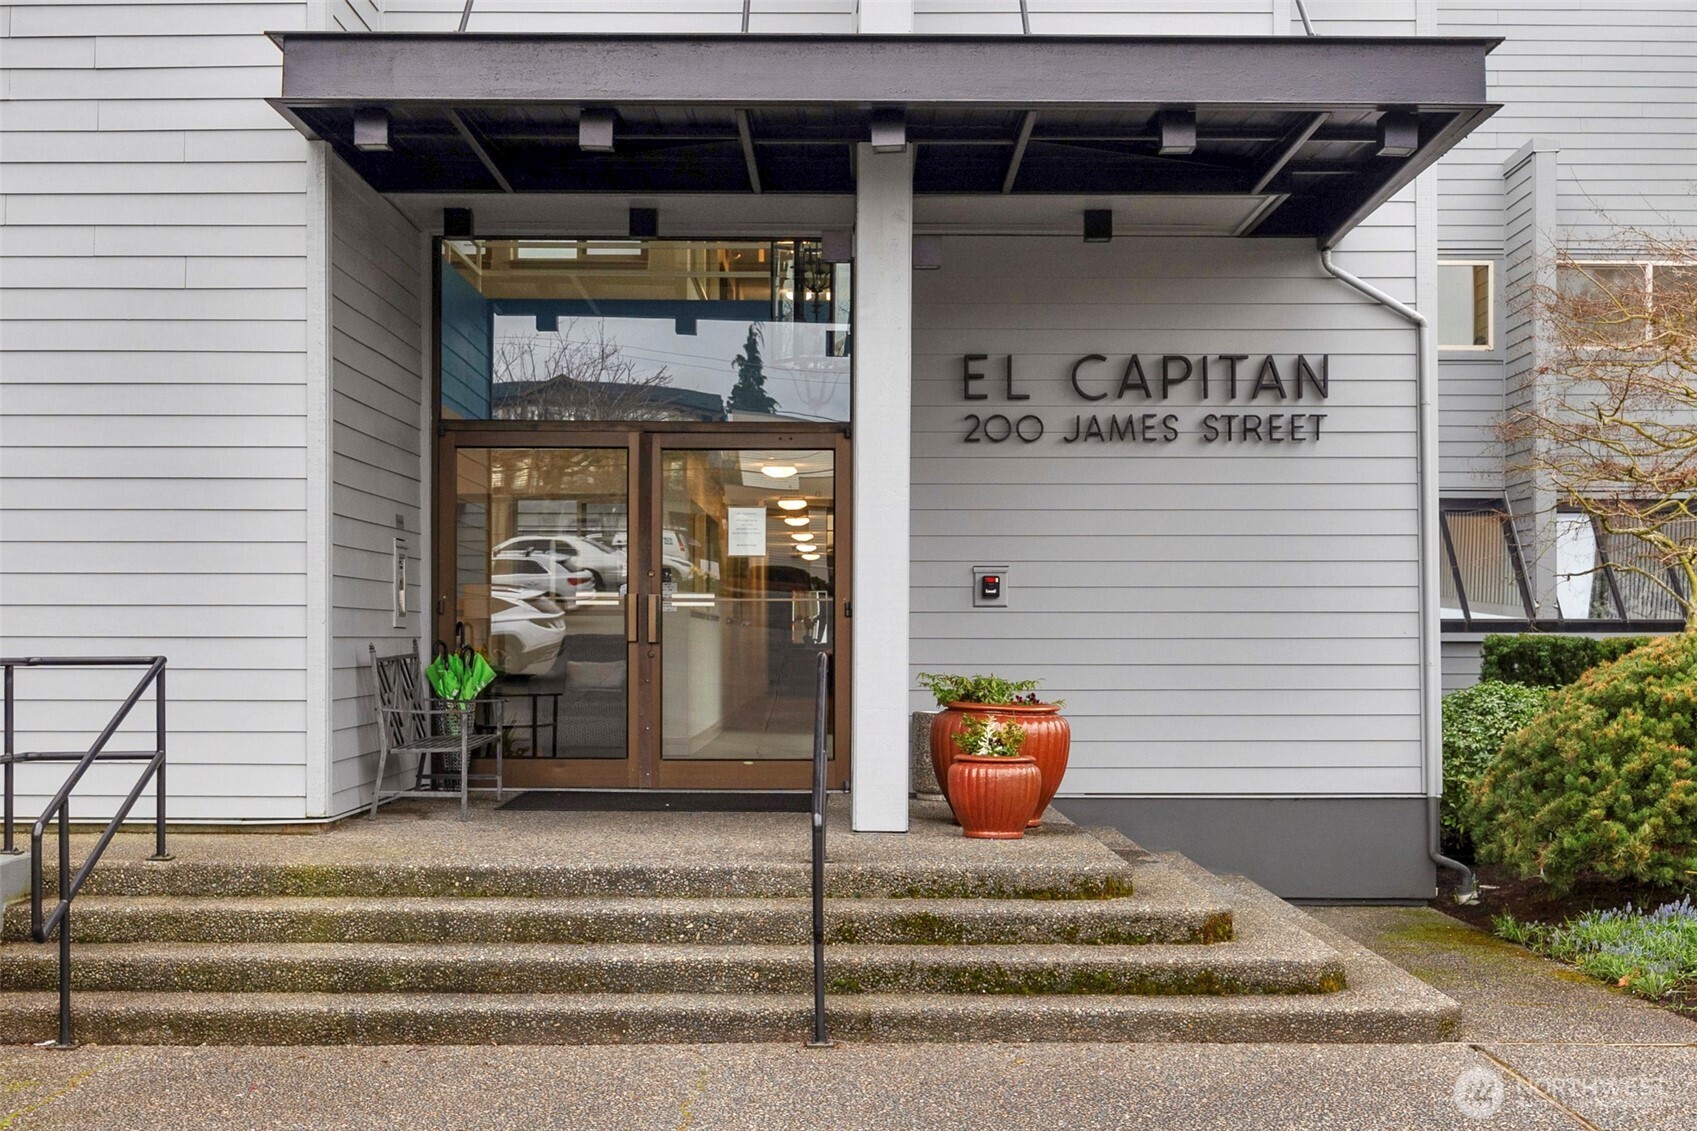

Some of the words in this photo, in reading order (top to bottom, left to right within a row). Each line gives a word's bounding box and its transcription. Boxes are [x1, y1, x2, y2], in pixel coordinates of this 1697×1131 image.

[963, 353, 1030, 400] EL
[1071, 354, 1328, 400] CAPITAN
[963, 414, 1044, 443] 200
[1063, 414, 1179, 443] JAMES
[1202, 414, 1328, 443] STREET
